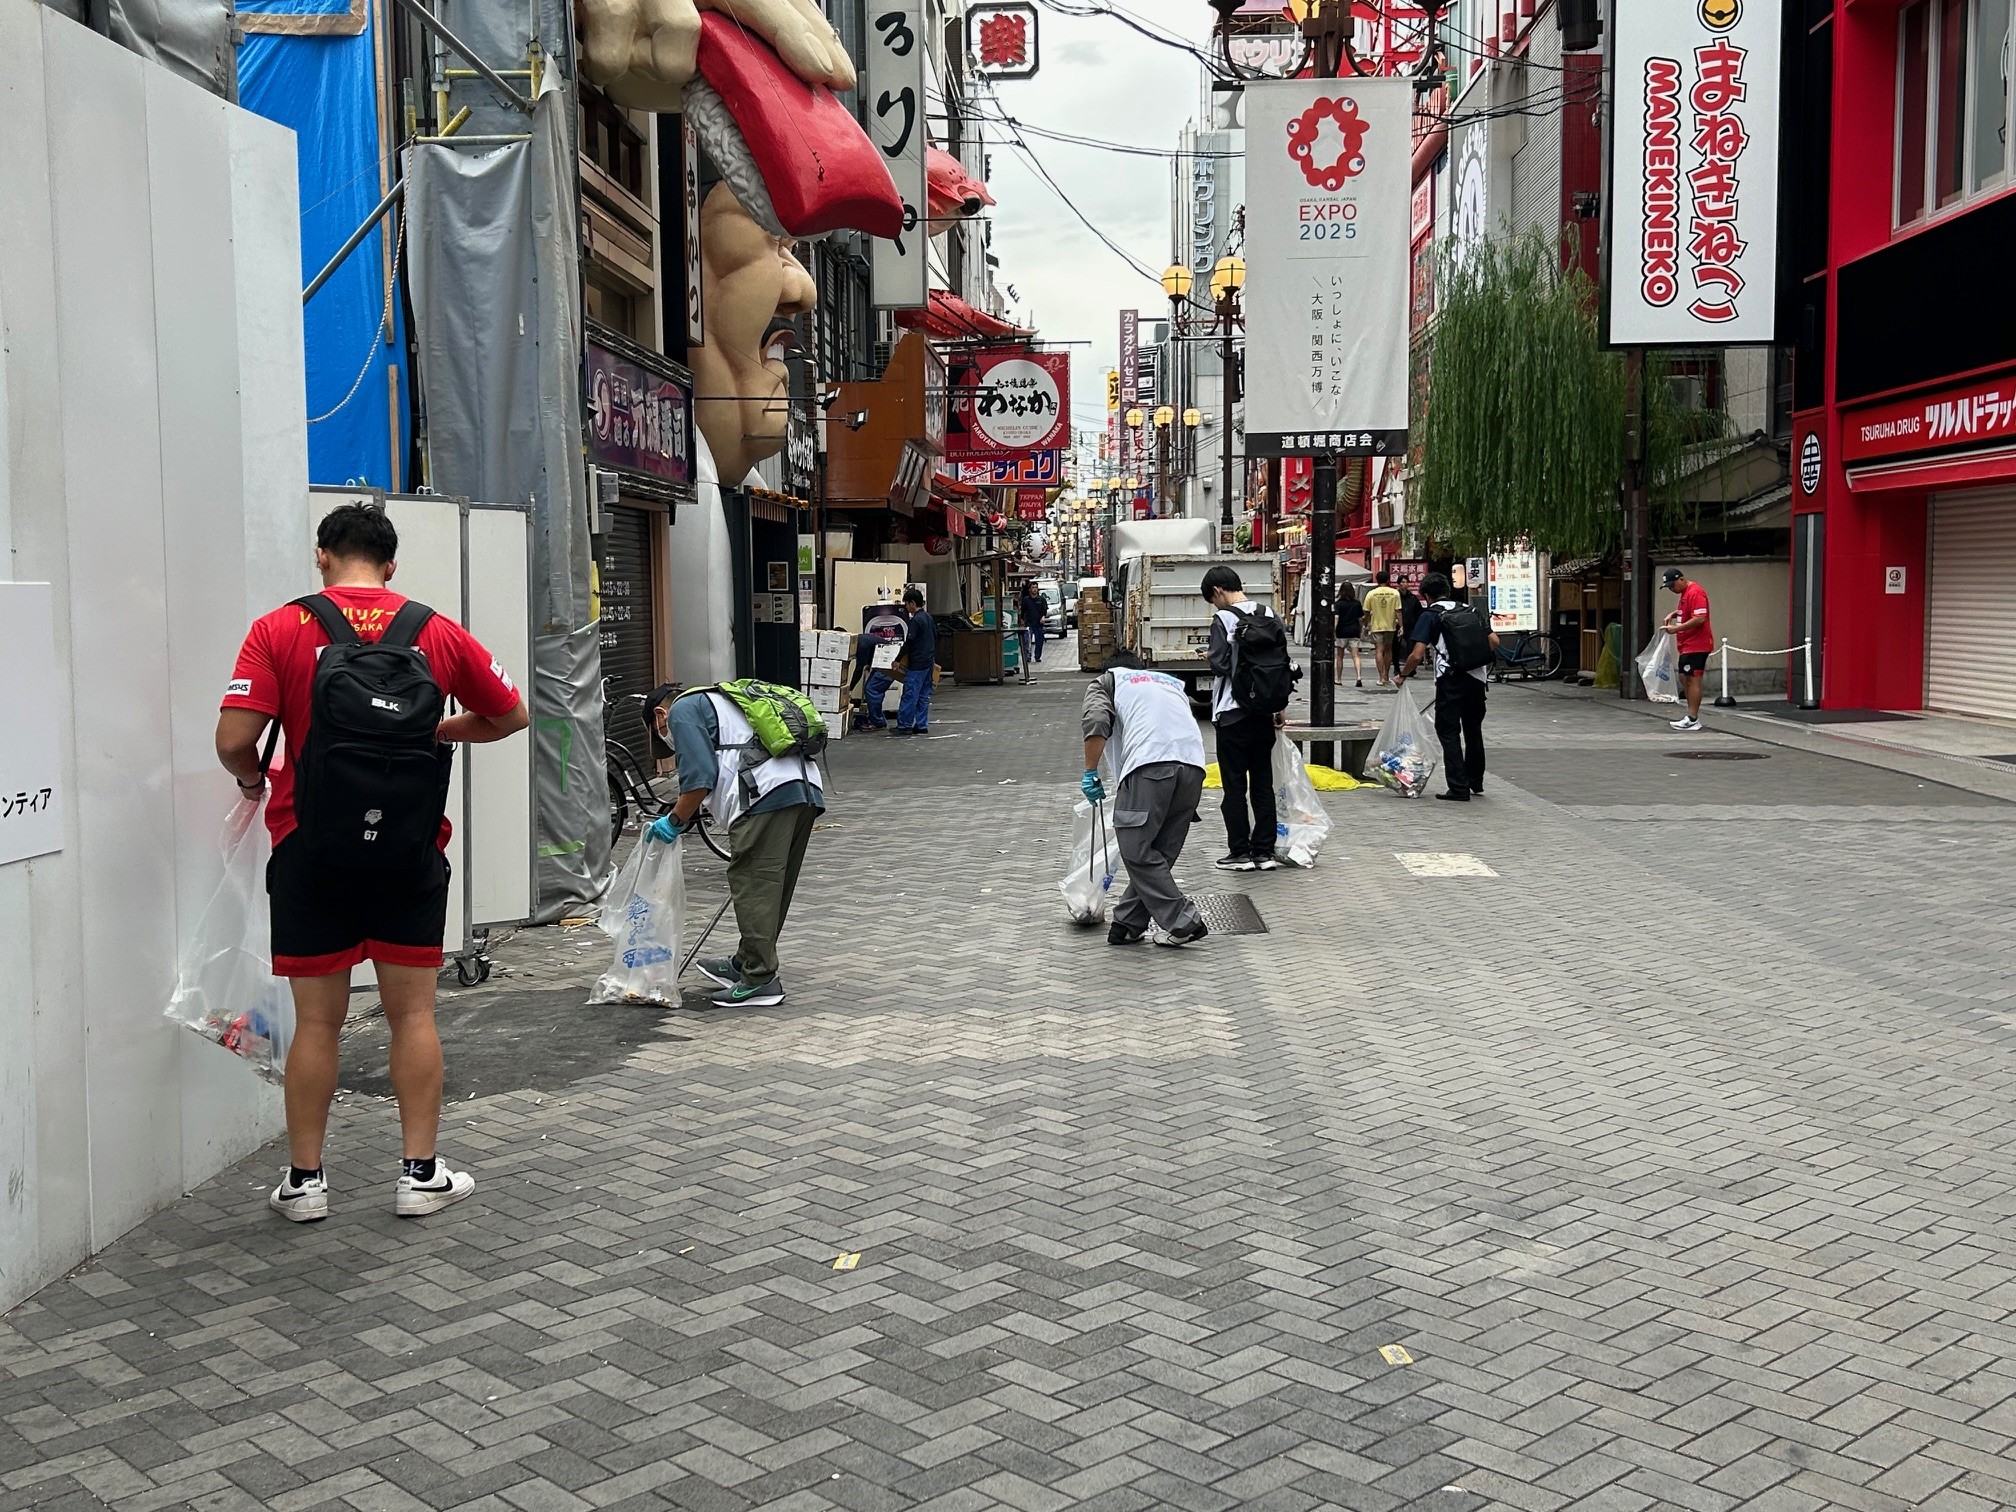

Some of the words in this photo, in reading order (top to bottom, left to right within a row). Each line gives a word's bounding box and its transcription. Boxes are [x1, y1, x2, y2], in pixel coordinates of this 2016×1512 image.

[1643, 57, 1681, 306] MANEKINEKO
[1687, 37, 1749, 322] まねきねこ
[1299, 203, 1357, 221] EXPO
[687, 161, 699, 324] 串かつ
[1299, 223, 1357, 241] 2025
[1124, 312, 1135, 388] カラオケパセラ
[977, 390, 1051, 417] わなか
[972, 422, 997, 449] TAKOYAKI
[1041, 422, 1063, 447] WANAKA
[1281, 433, 1373, 449] 道頓堀商店会
[1861, 421, 1896, 443] TSURUHA
[1897, 416, 1920, 437] DRUG
[1019, 493, 1044, 501] TEPPAN
[352, 623, 383, 632] SAKA
[371, 698, 400, 712] BLK
[2, 787, 52, 818] ンティア
[363, 829, 378, 842] 67
